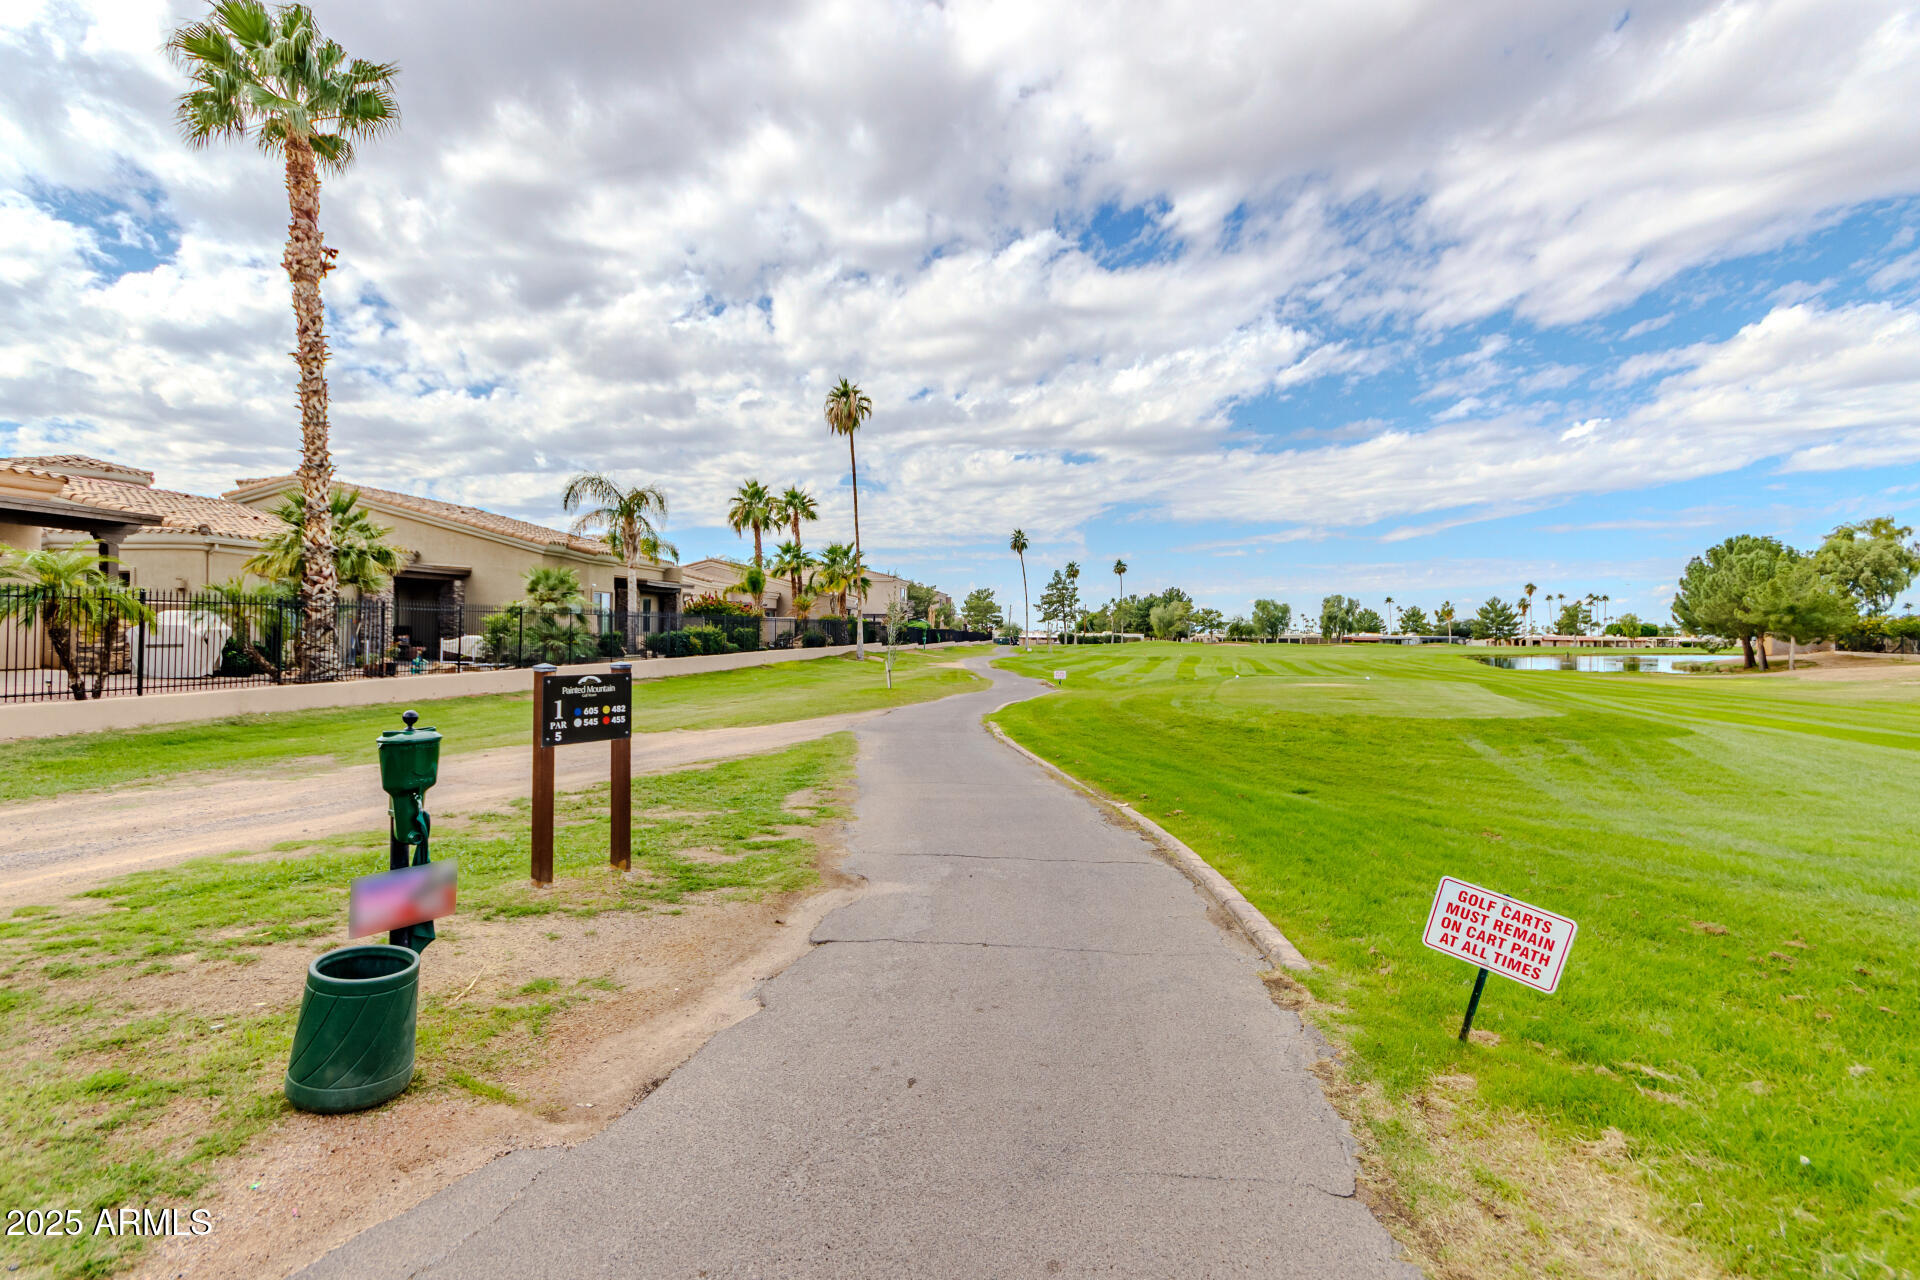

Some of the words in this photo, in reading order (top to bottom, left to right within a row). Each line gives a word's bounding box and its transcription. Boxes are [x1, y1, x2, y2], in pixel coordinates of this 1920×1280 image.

[562, 685, 585, 695] Painted
[587, 684, 616, 694] Mountain
[554, 700, 563, 720] 1
[583, 707, 599, 715] 605
[611, 705, 626, 713] 482
[583, 718, 599, 727] 545
[611, 716, 626, 724] 455
[550, 721, 567, 730] PAR
[555, 731, 562, 741] 5
[1458, 890, 1497, 913] GOLF
[1501, 905, 1553, 934] CARTS
[1445, 902, 1490, 926] MUST
[1492, 919, 1556, 952] REMAIN
[1441, 916, 1462, 933] ON
[1466, 926, 1507, 949] CART
[1510, 942, 1551, 967] PATH
[1439, 932, 1459, 948] AT
[1461, 941, 1487, 960] ALL
[1493, 951, 1542, 980] TIMES
